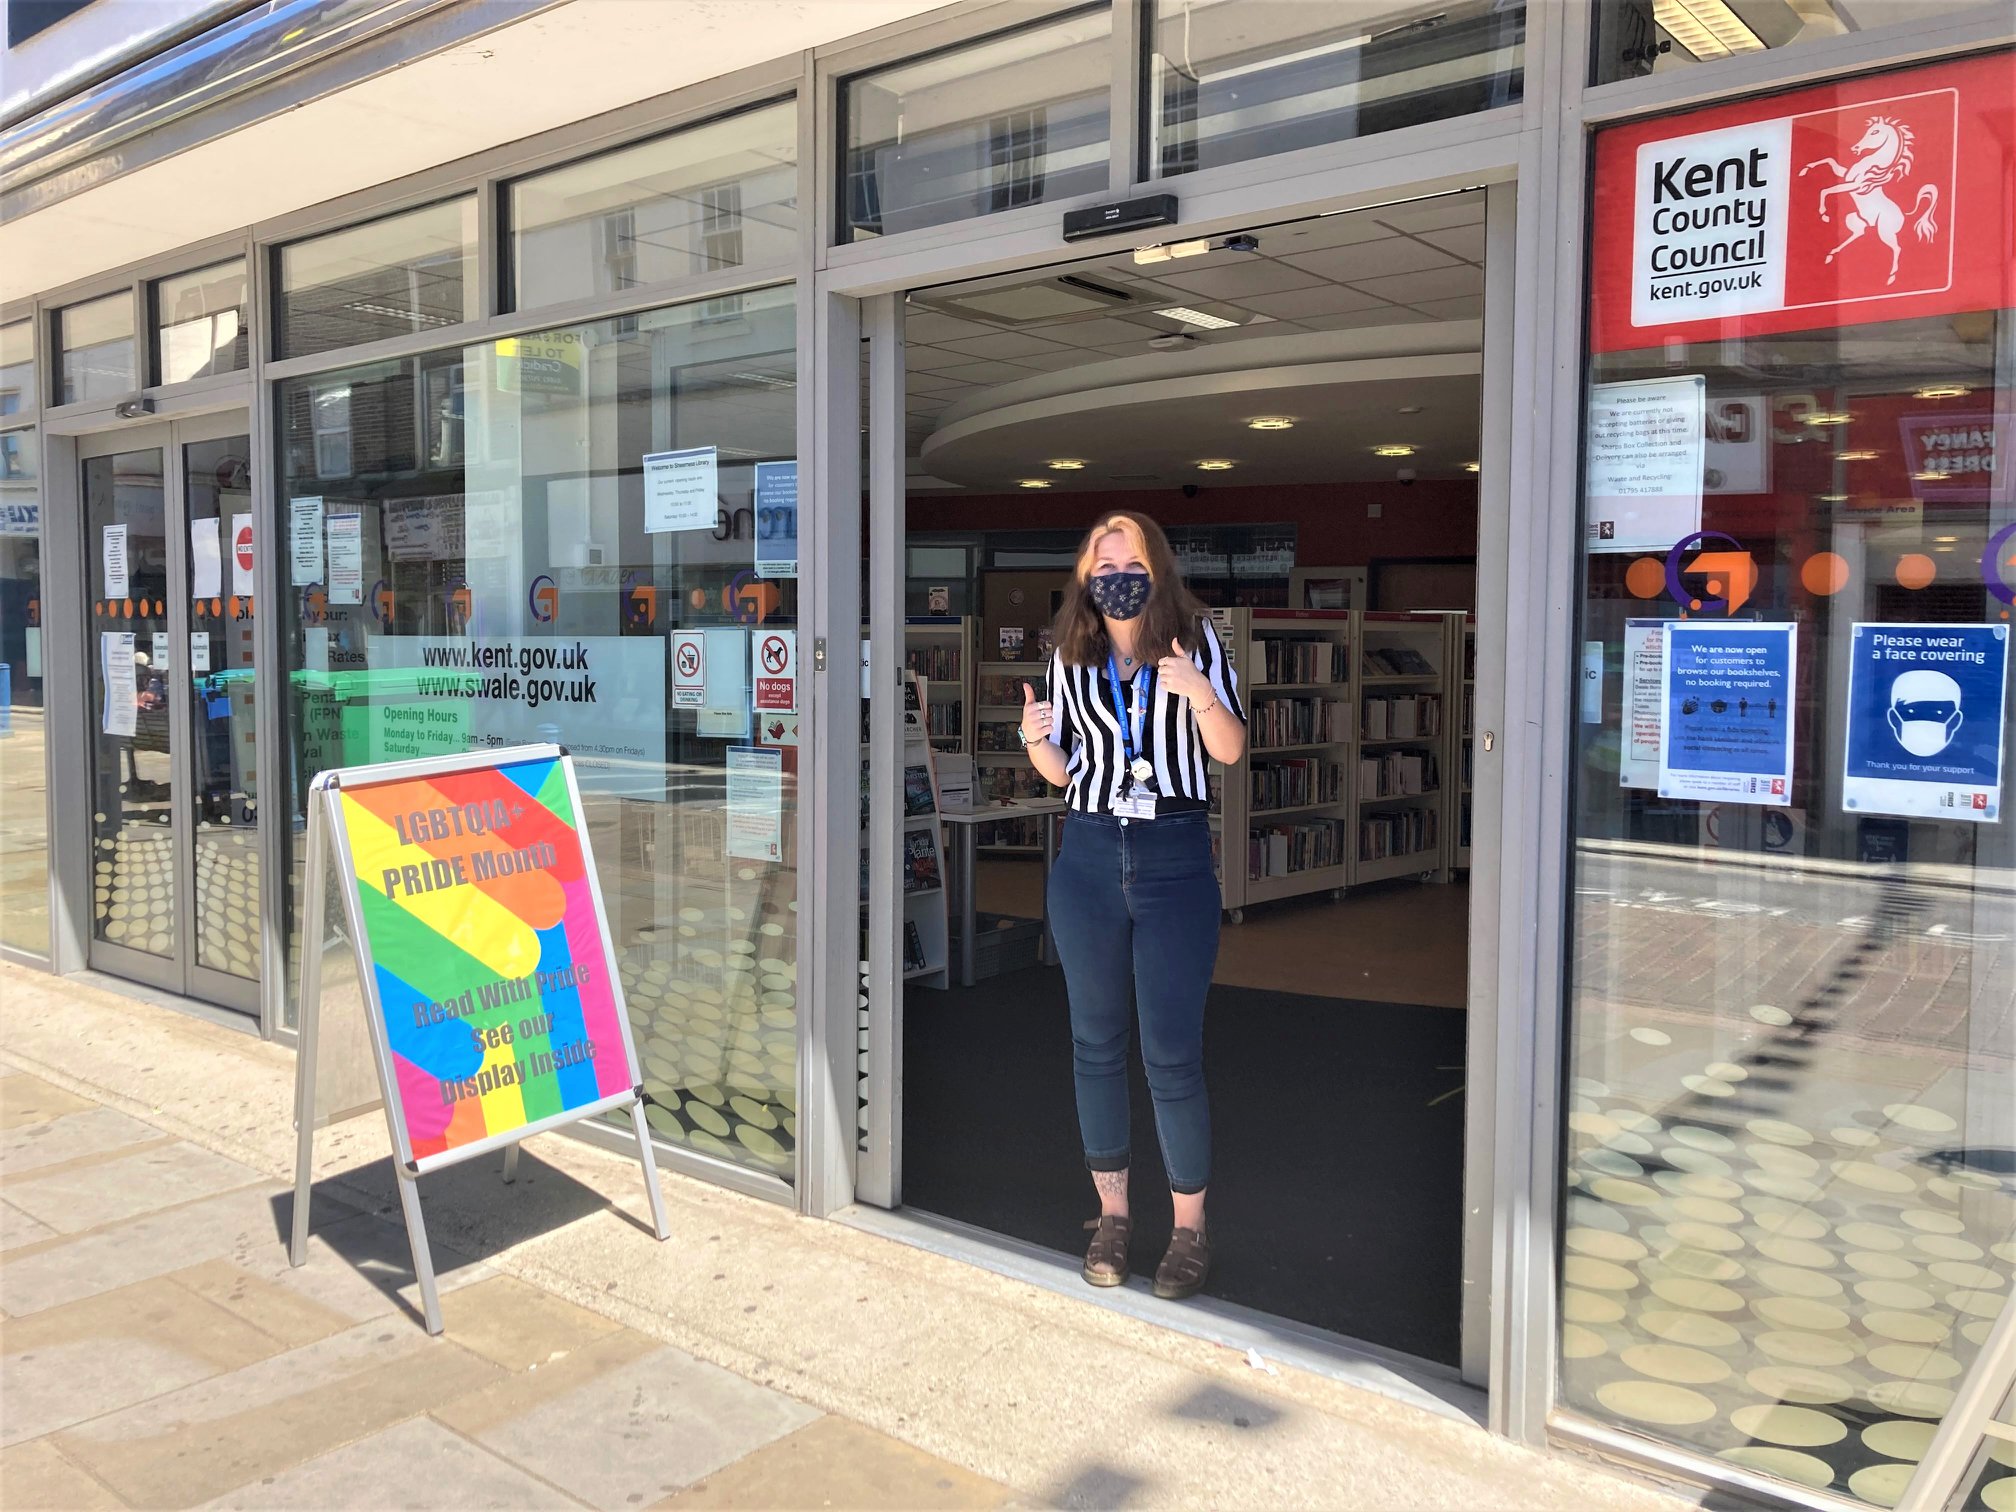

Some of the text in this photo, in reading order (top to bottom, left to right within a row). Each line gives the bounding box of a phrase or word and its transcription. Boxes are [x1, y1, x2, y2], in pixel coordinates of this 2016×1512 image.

[1653, 148, 1768, 204] Kent
[1653, 199, 1767, 235] County
[1651, 230, 1765, 271] Council
[1650, 271, 1762, 300] kent.gov.uk
[1633, 408, 1661, 416] currently
[1629, 418, 1656, 426] batteries
[1666, 417, 1685, 425] giving
[1607, 430, 1634, 438] recycling
[1637, 440, 1667, 448] Collection
[1873, 634, 1964, 647] Please wear
[1691, 645, 1707, 653] We
[1746, 647, 1767, 655] open
[1872, 649, 1985, 664] a face covering
[423, 642, 588, 675] www.kent.gov.uk
[1695, 656, 1708, 664] for
[1677, 667, 1708, 675] browse
[1727, 668, 1781, 677] bookshelves,
[417, 673, 596, 708] www.swale.gov.uk
[760, 682, 791, 692] No dogs
[1699, 678, 1731, 688] booking
[1733, 680, 1771, 689] required.
[384, 707, 458, 724] Opening Hours
[384, 728, 414, 740] Monday
[417, 730, 425, 739] to
[462, 733, 478, 744] 9am
[487, 734, 503, 747] 5pm
[384, 742, 420, 756] Saturday
[1866, 760, 1974, 774] Thank you for your support
[394, 799, 525, 846] LGBTQIA+
[383, 840, 557, 899] PRIDE Month
[413, 962, 591, 1028] Read With Pride
[470, 1011, 555, 1054] See our
[439, 1037, 596, 1106] Display Inside
